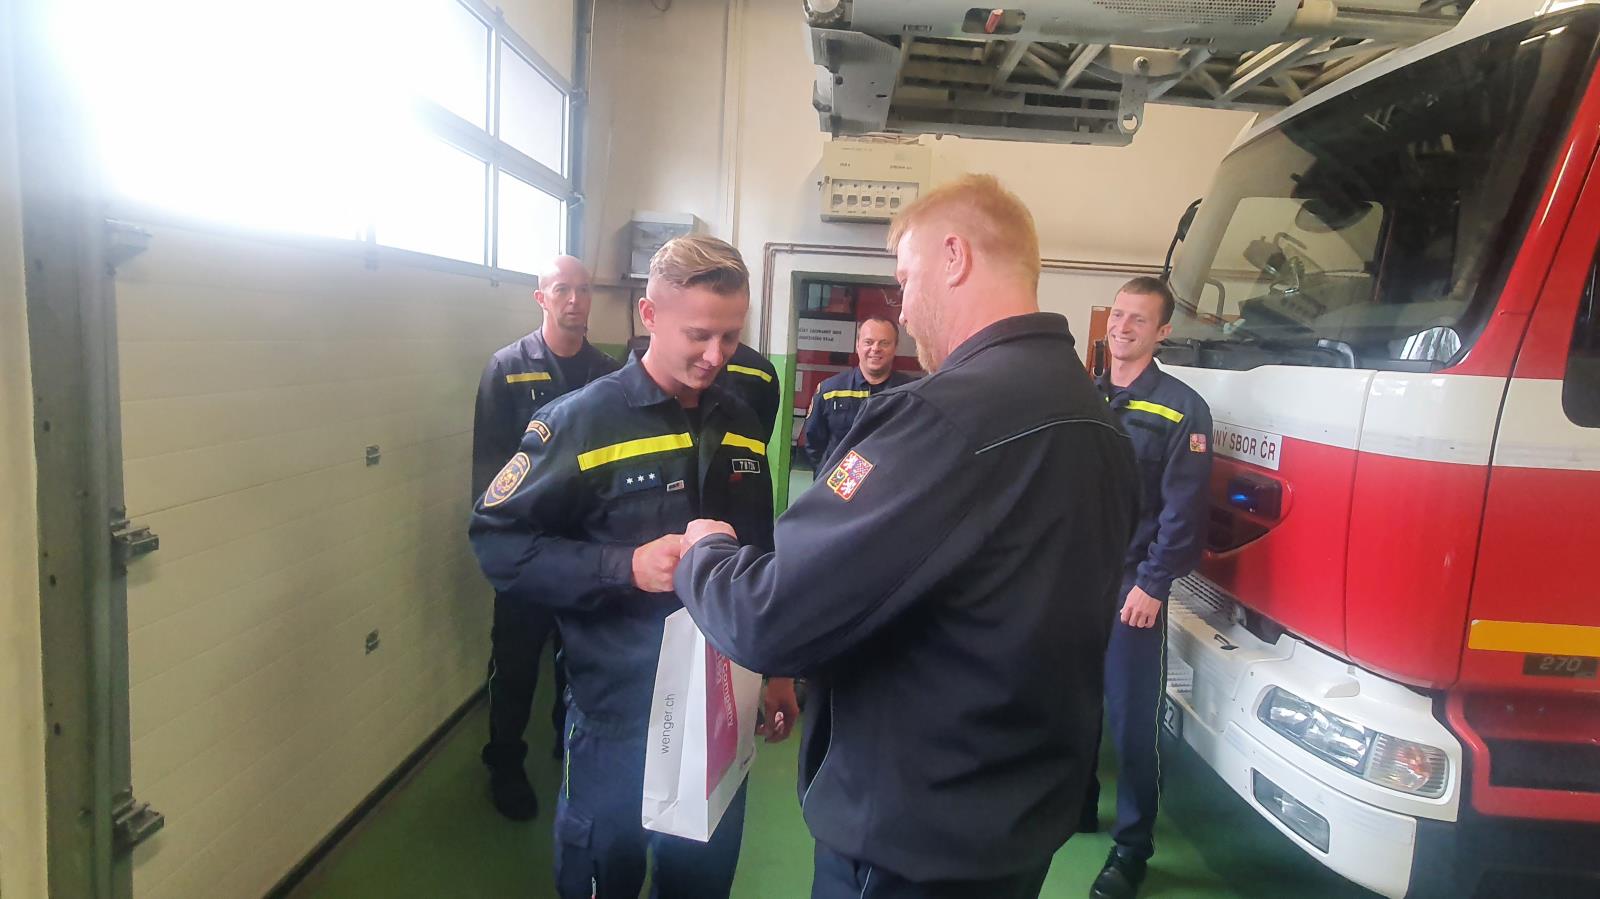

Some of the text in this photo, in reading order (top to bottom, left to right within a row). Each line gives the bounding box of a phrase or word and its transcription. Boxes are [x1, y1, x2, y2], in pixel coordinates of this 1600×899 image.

[1230, 433, 1257, 456] SBOR
[1260, 434, 1276, 461] ČR
[1540, 656, 1582, 672] 270
[723, 662, 734, 728] company
[661, 693, 677, 754] wenger.ch
